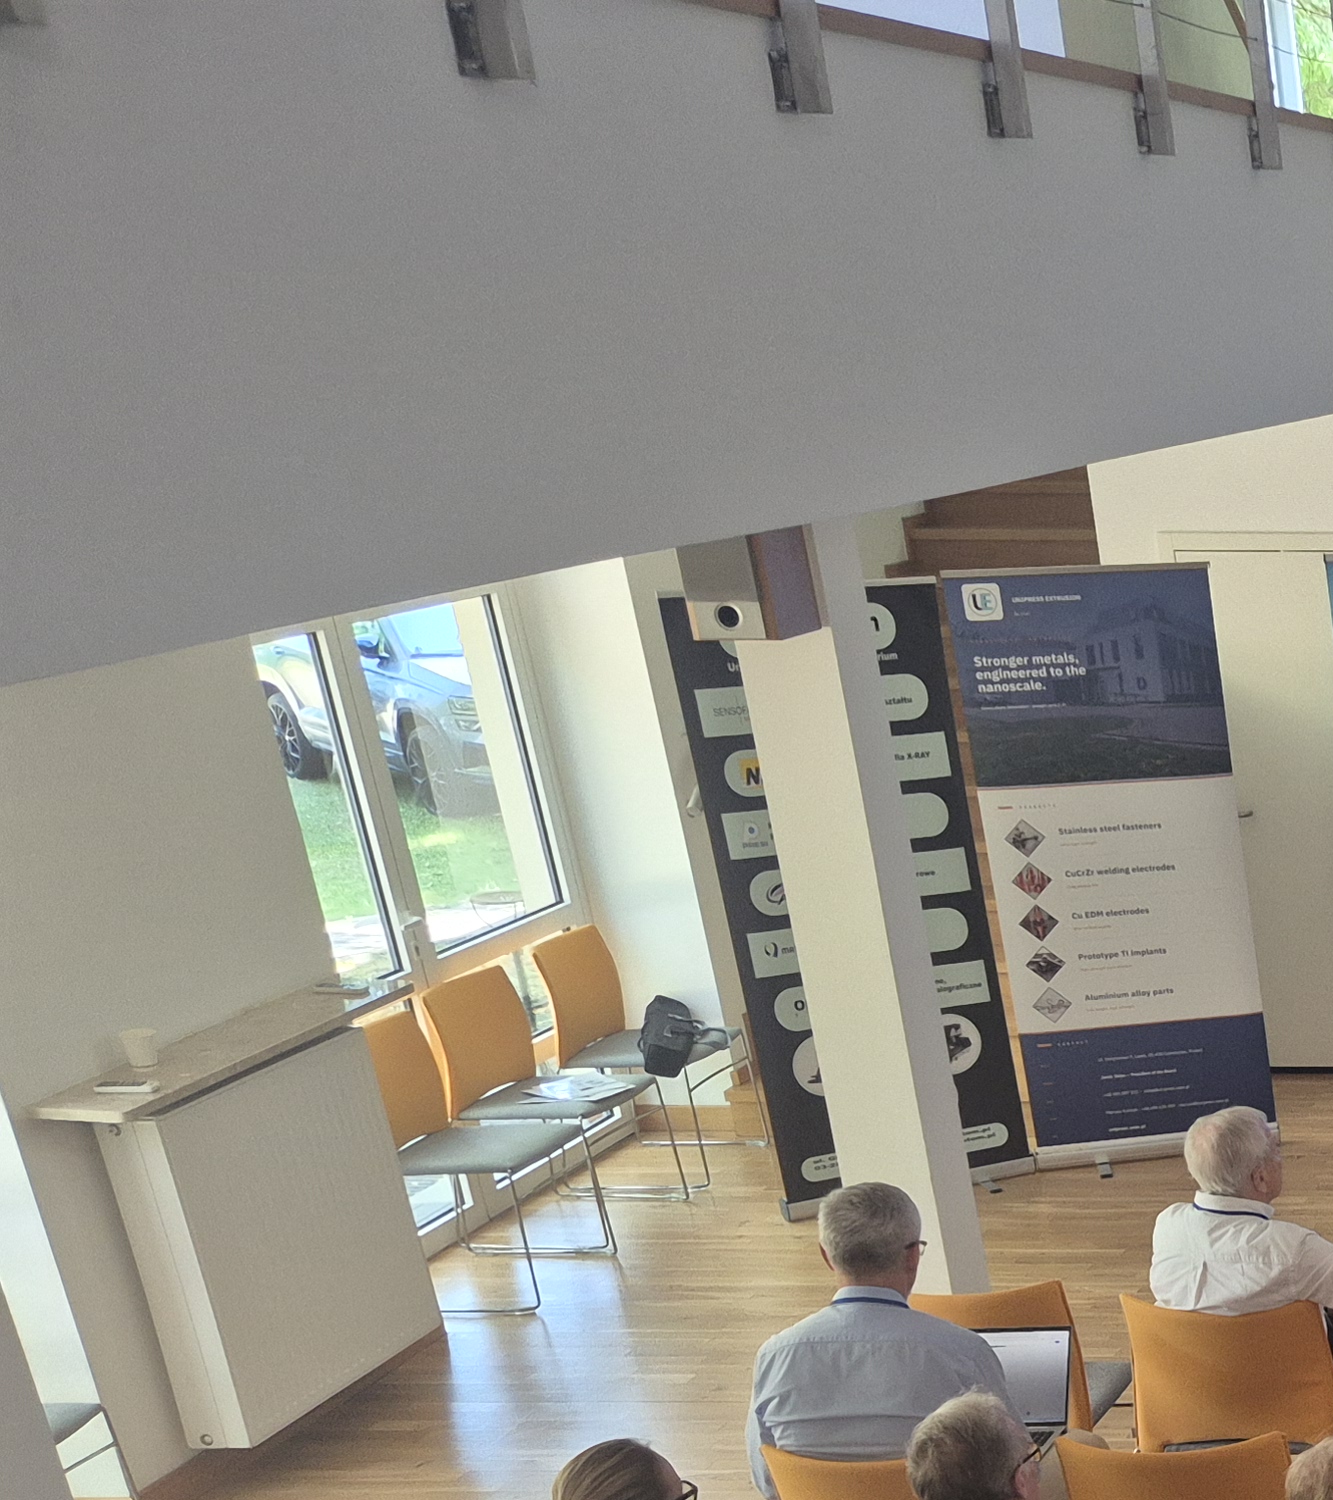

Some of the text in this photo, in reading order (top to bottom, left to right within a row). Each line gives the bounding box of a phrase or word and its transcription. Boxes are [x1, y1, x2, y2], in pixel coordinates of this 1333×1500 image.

[973, 652, 1079, 669] Stronger metals,
[975, 665, 1086, 682] engineered to the
[978, 679, 1046, 693] nanoscale.
[907, 751, 931, 761] X-RAY
[1058, 821, 1162, 836] Stainless steel fasteners
[1065, 863, 1176, 878] CuCrZr welding electrodes
[1071, 906, 1150, 920] Cu EDM electrodes
[1078, 950, 1119, 961] Prototype
[1085, 986, 1174, 1002] Aluminium alloy parts
